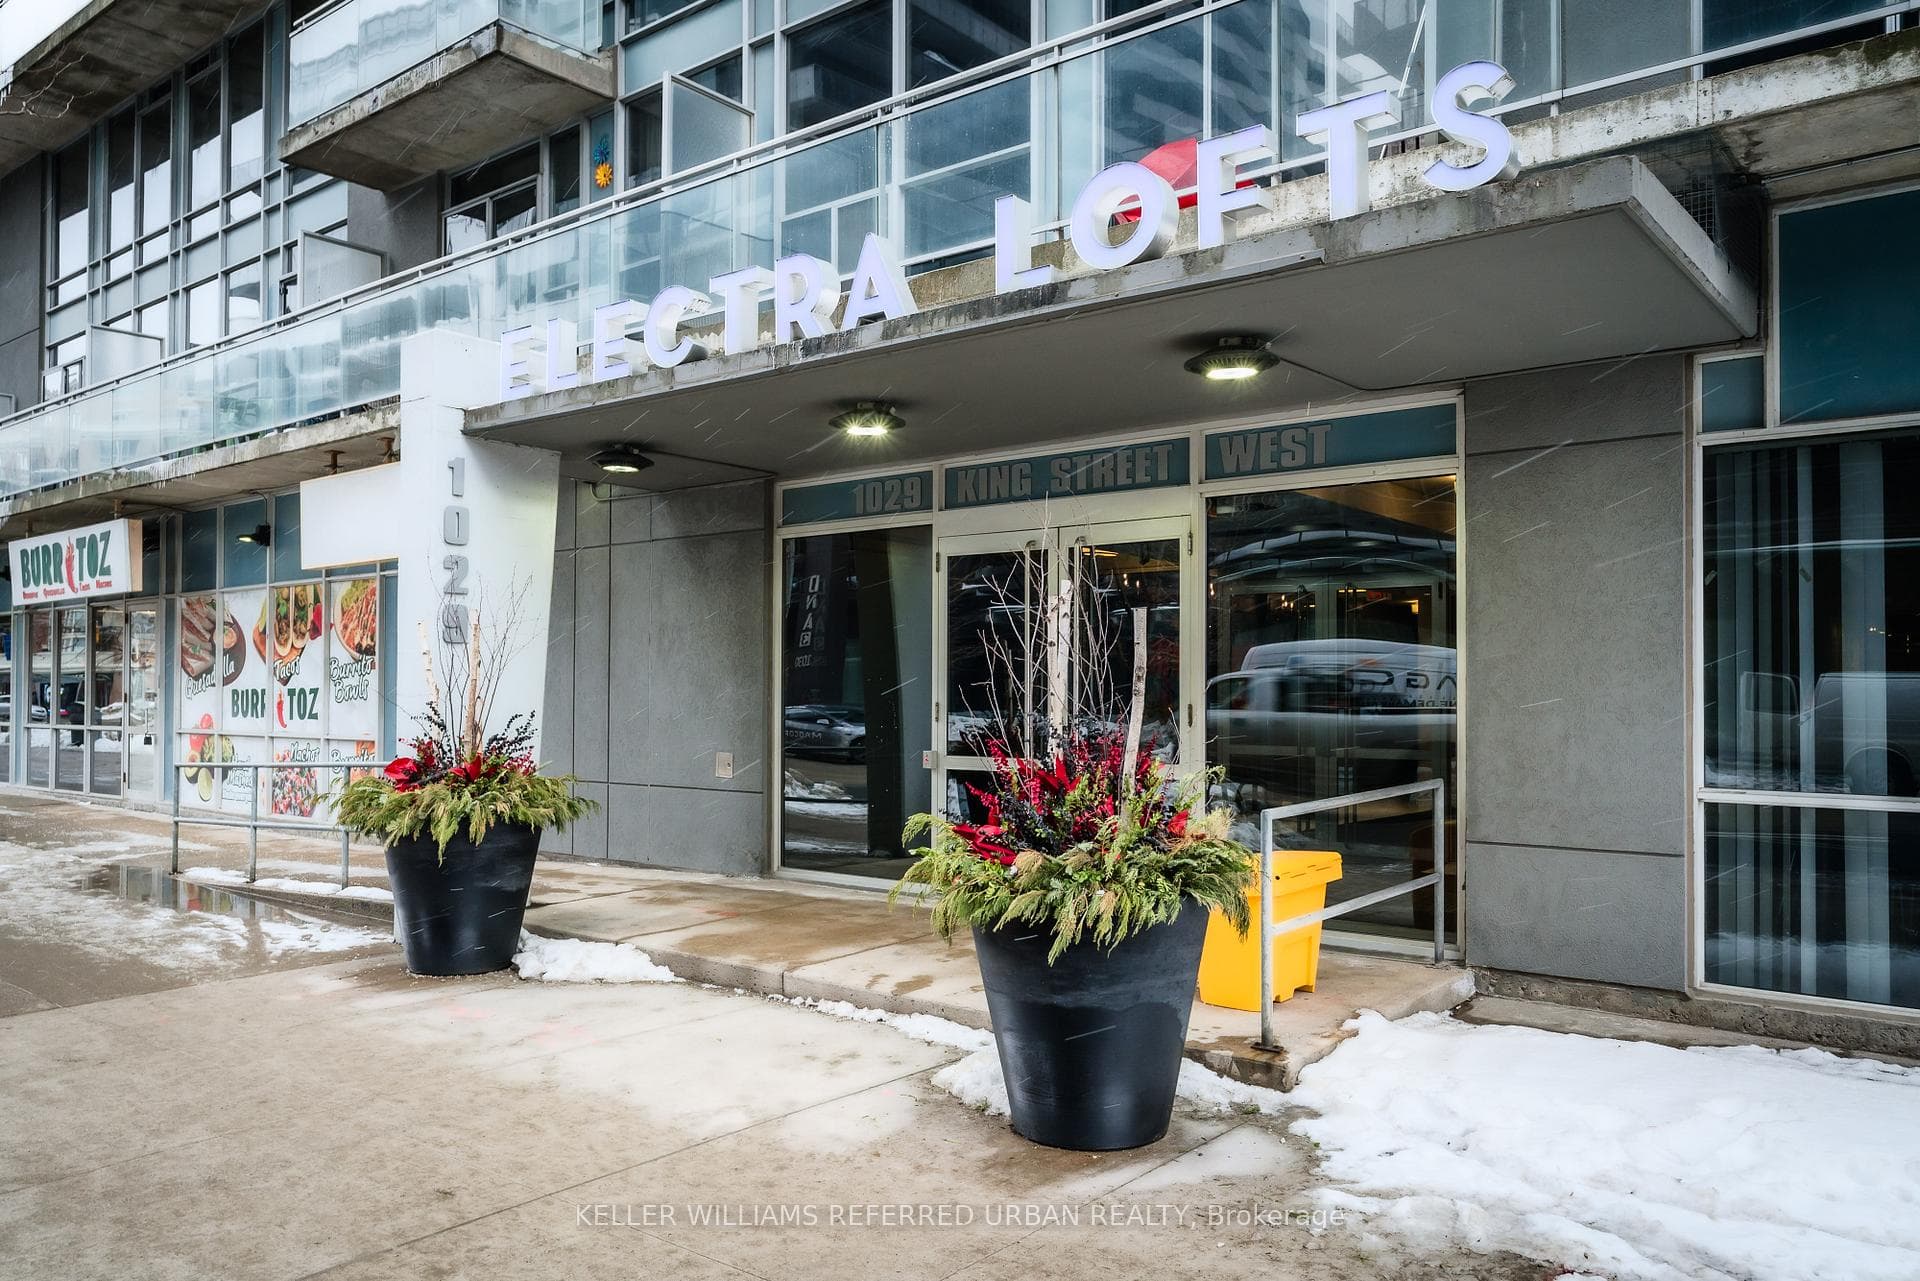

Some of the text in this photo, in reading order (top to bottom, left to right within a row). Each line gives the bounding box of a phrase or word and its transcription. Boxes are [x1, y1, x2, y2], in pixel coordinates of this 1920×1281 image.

[500, 60, 1520, 399] ELECTRA LOFTS
[853, 425, 1332, 515] 1029 KING STREET WEST
[442, 457, 470, 645] 1029
[273, 655, 300, 681] Tacos
[329, 655, 374, 681] Burrito
[335, 677, 370, 703] Bowls
